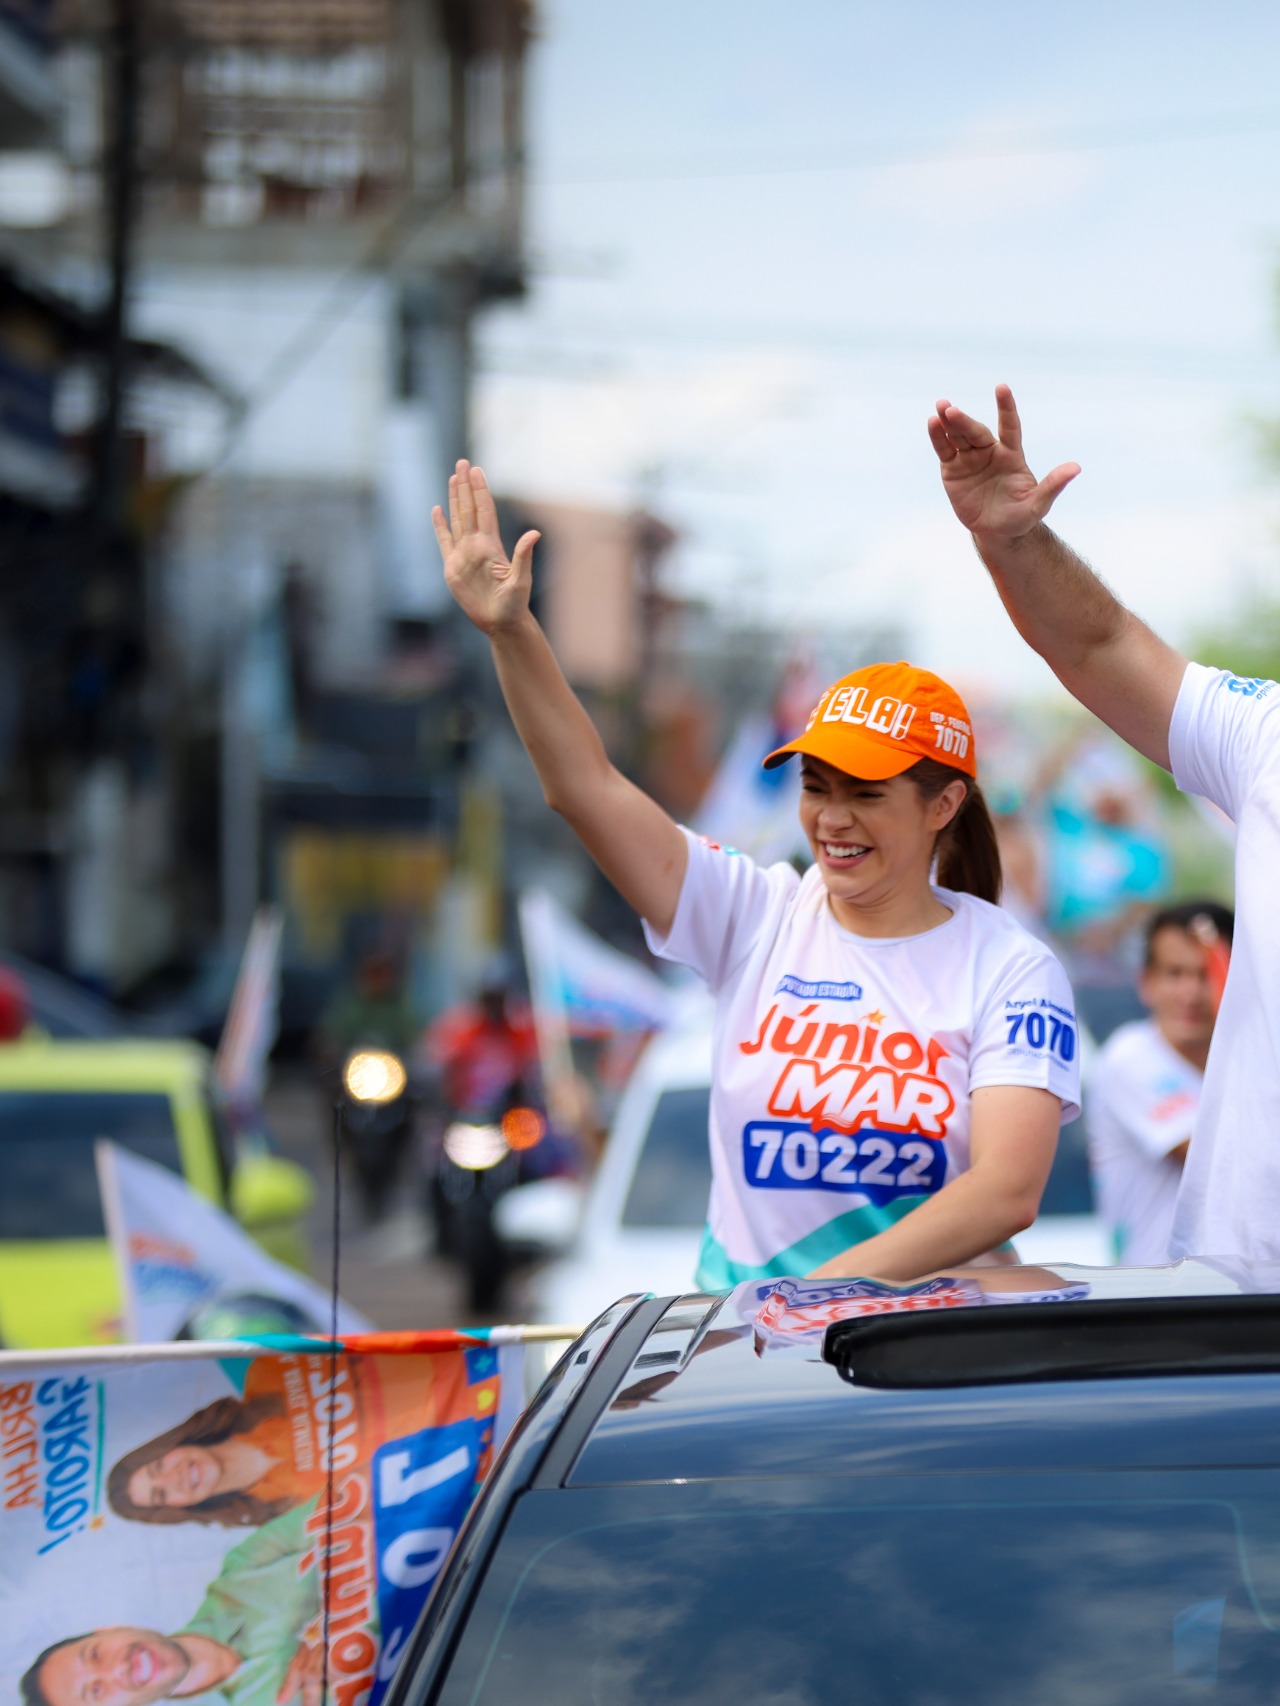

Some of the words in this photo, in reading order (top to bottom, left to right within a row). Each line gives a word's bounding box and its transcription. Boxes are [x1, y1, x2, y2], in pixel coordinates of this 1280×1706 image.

[822, 686, 917, 740] ELA!
[934, 724, 969, 759] 7070
[739, 1004, 950, 1076] Júnior
[1006, 1012, 1075, 1062] 7070
[768, 1058, 955, 1139] MAR
[751, 1129, 935, 1186] 70222
